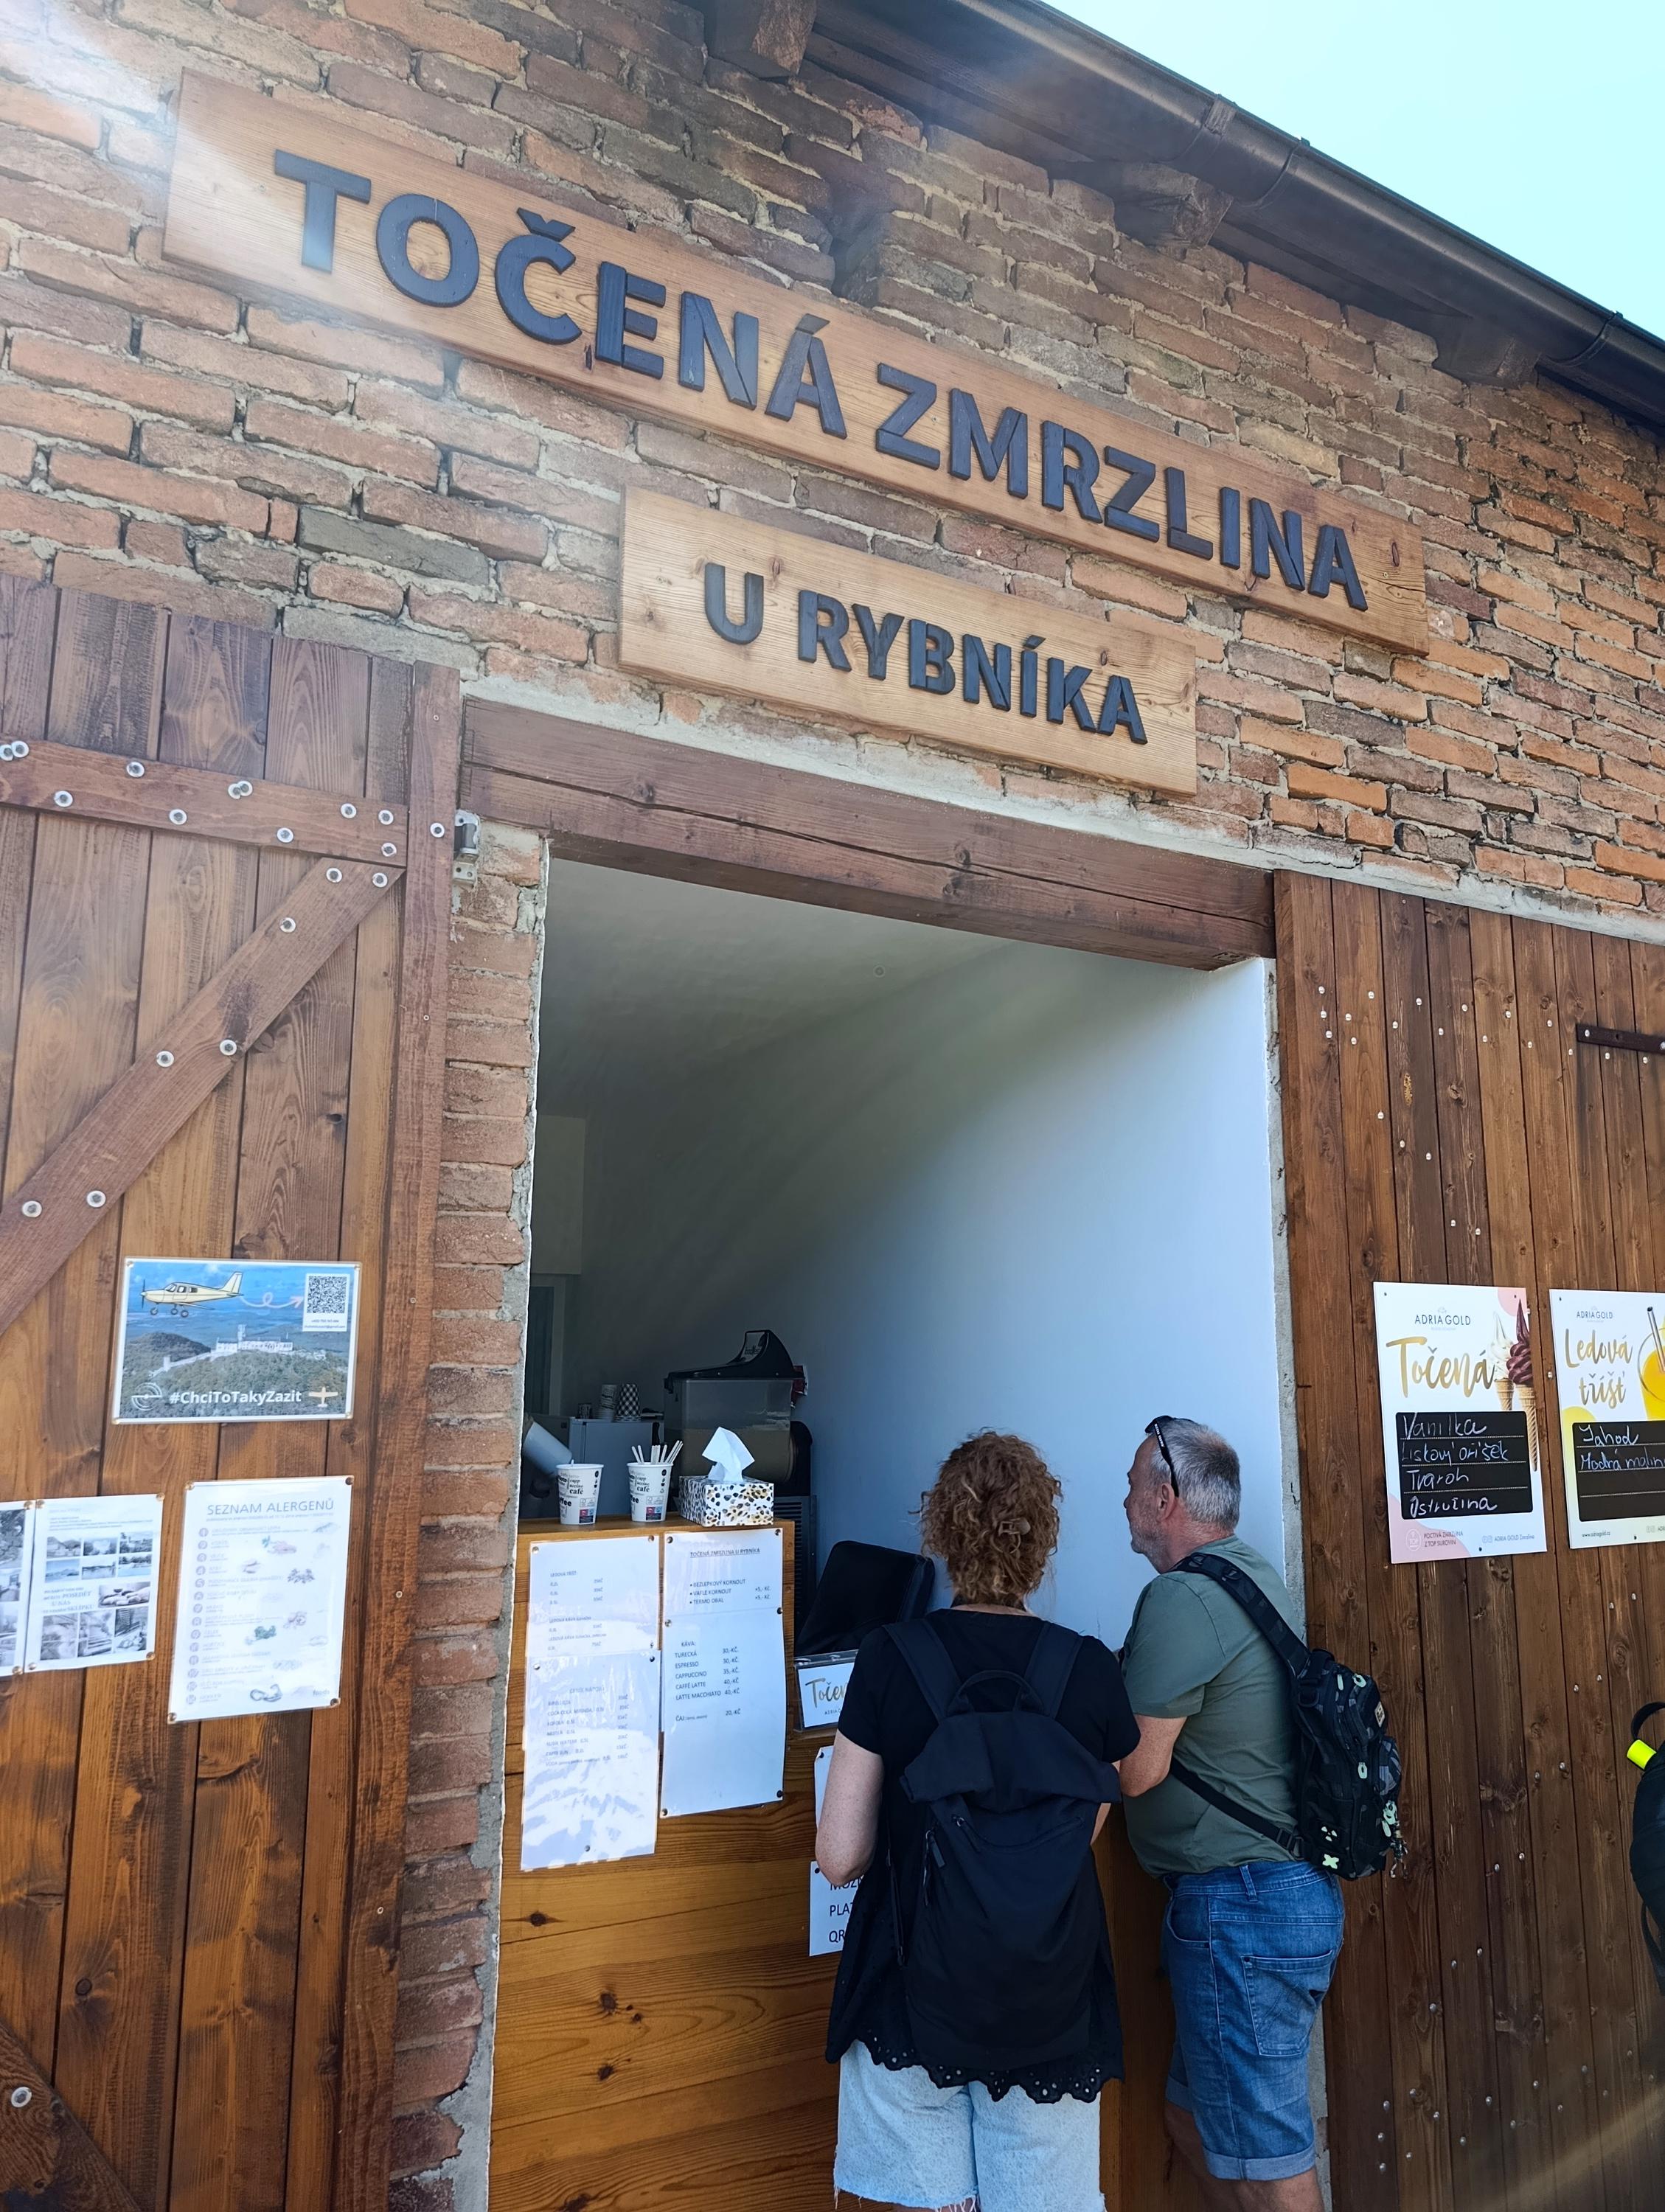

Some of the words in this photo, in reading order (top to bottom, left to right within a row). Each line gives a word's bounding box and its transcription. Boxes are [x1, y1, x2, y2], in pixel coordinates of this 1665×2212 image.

[274, 149, 847, 439] TOČENÁ
[875, 363, 1369, 611] ZMRZLINA
[704, 562, 764, 645] U
[798, 589, 1148, 743] RYBNÍKA
[1565, 1328, 1633, 1368] Ledová
[1386, 1336, 1496, 1398] Točená
[169, 1391, 302, 1406] #ChciToTakyZazit
[1402, 1412, 1488, 1441] Vanilka
[1625, 1446, 1665, 1469] malin
[1406, 1467, 1470, 1492] Tvaroh
[207, 1502, 263, 1516] SEZNAM
[265, 1498, 335, 1513] ALERGENŮ
[675, 1671, 707, 1680] CAPPUCCINO
[692, 1690, 721, 1699] MACCHIATO
[830, 1902, 855, 1916] PLA
